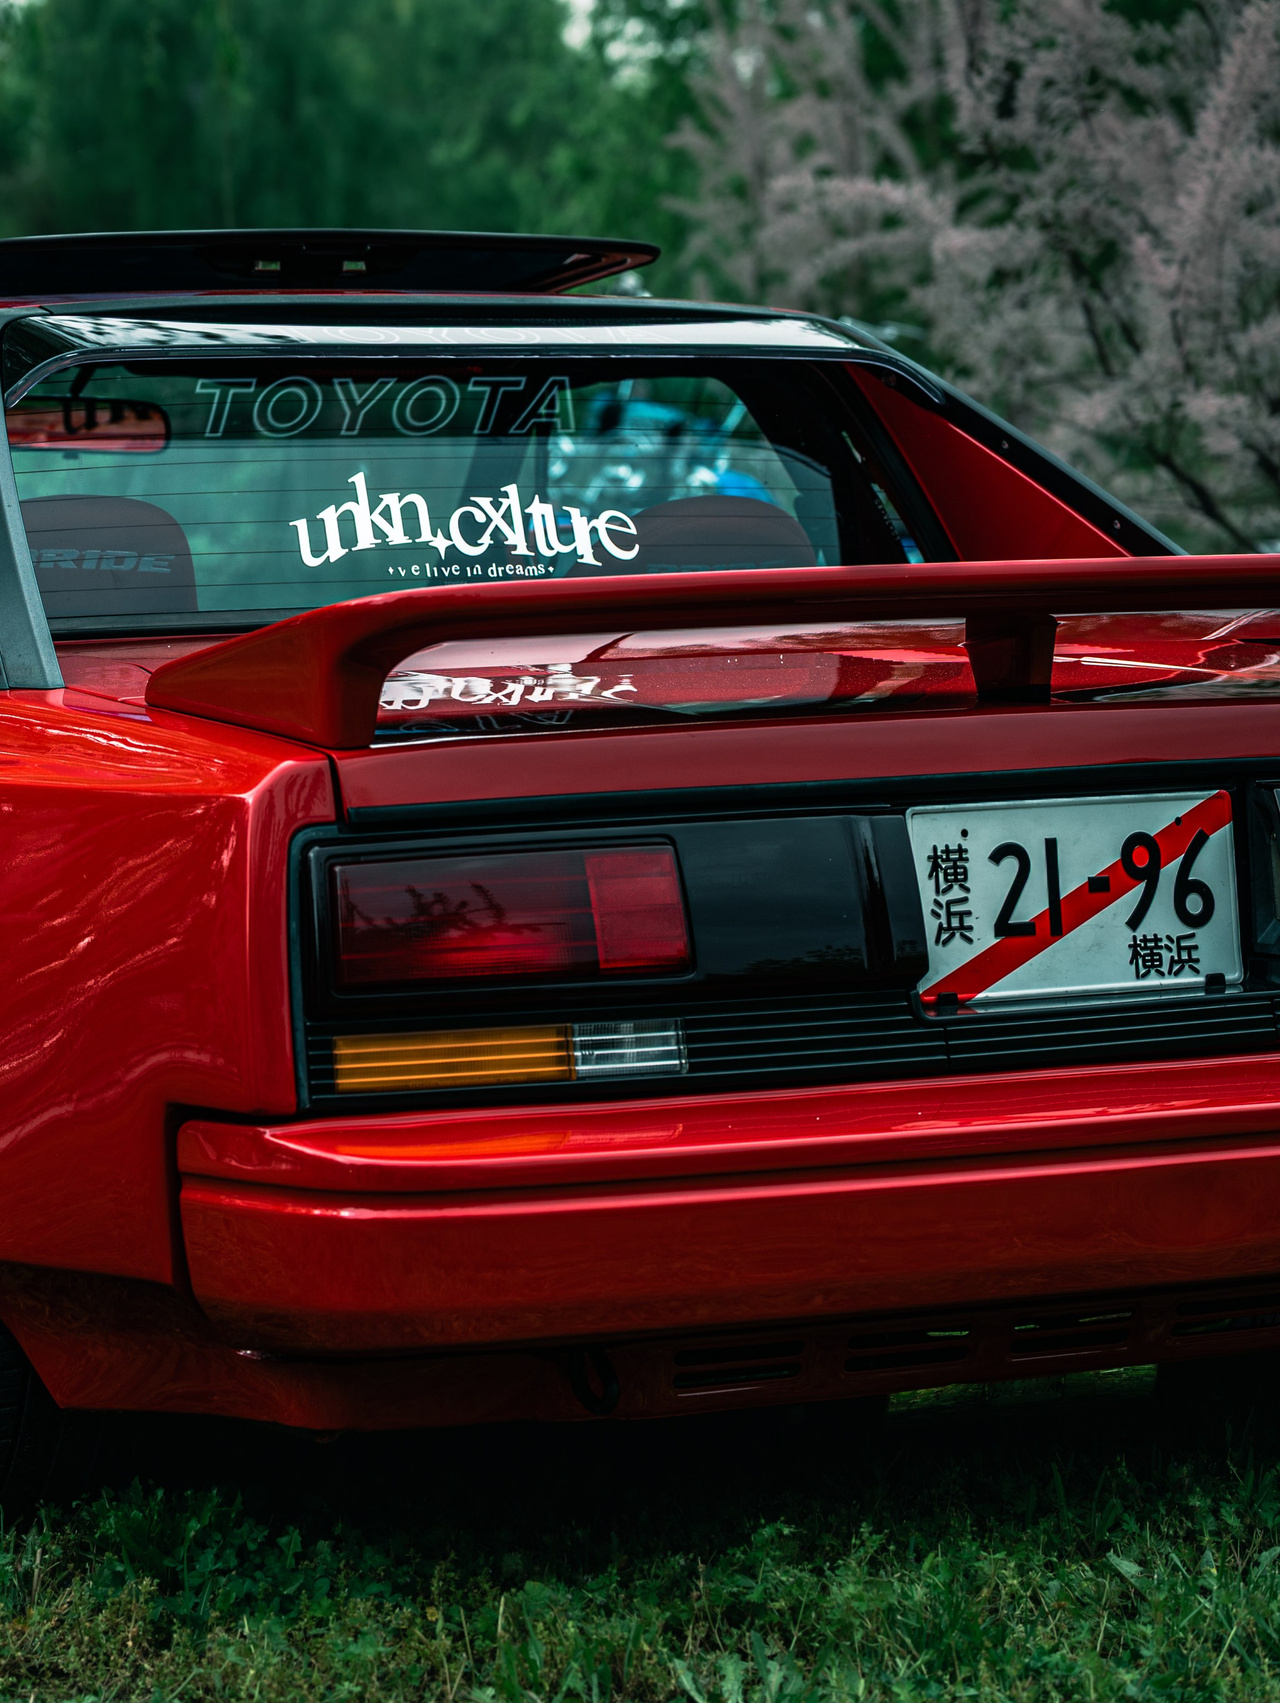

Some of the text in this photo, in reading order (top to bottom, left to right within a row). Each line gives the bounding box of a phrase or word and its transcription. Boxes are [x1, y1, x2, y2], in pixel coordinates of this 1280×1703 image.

[195, 375, 575, 437] TOYOTA
[425, 562, 460, 577] live
[466, 564, 482, 577] in
[488, 563, 546, 577] dreams
[927, 843, 974, 946] 横浜
[988, 828, 1216, 938] 21-96
[1128, 932, 1201, 979] 横浜
